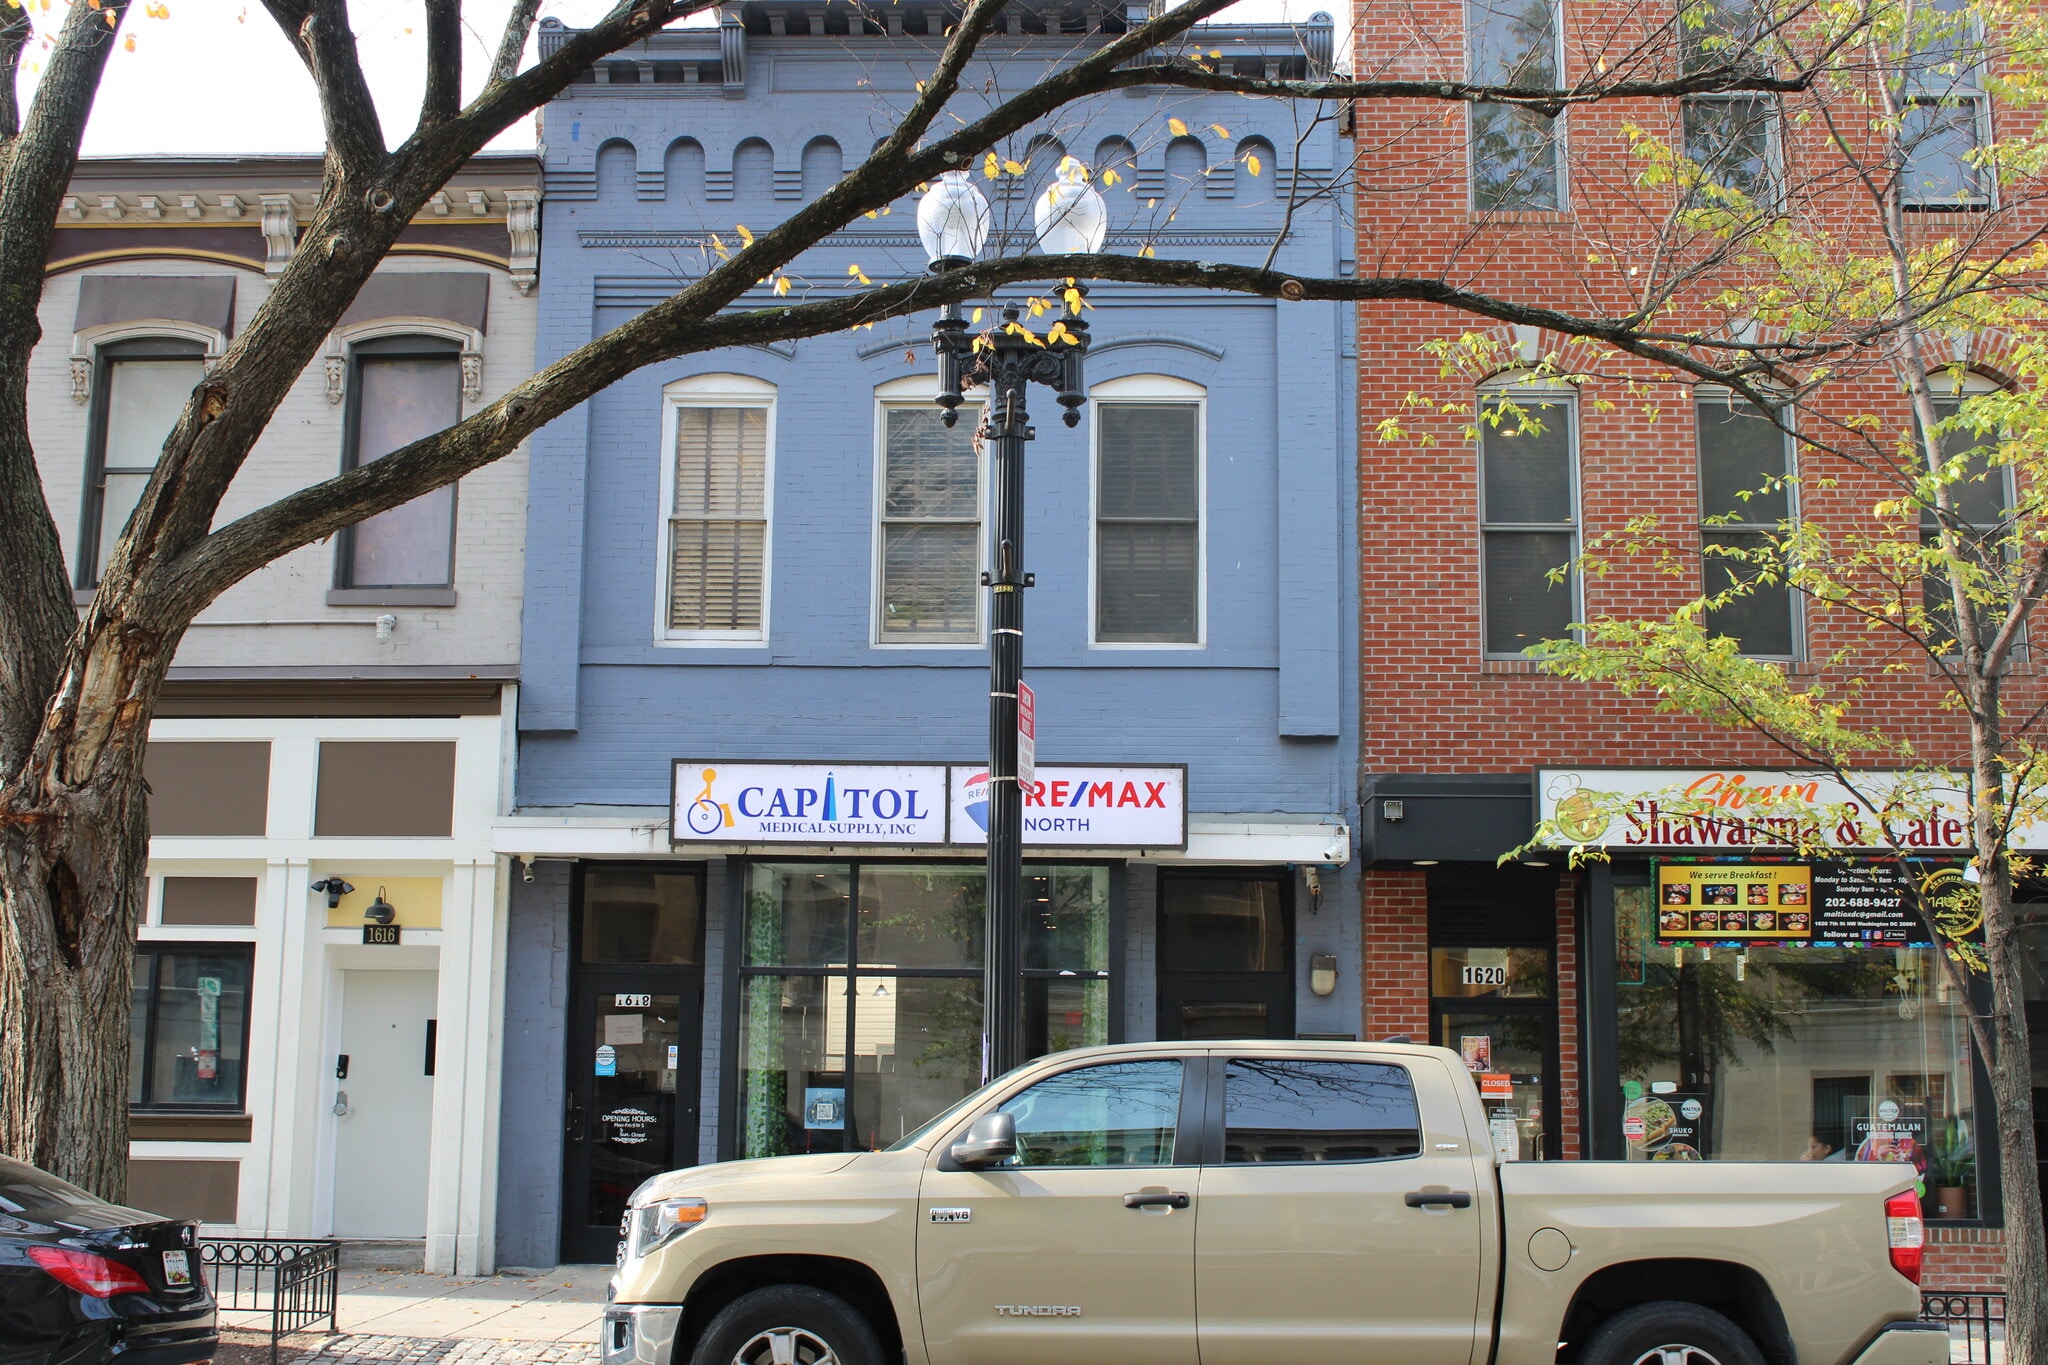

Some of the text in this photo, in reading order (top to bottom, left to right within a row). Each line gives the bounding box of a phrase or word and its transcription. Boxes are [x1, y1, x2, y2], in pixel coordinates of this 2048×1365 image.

[738, 771, 929, 821] CAPITOL
[1684, 773, 1819, 816] Sham
[759, 822, 917, 836] MEDICAL SUPPLY, INC
[1025, 818, 1090, 832] NORTH
[1625, 800, 1963, 847] Shawarma & Cafe
[1689, 871, 1703, 879] We
[1729, 870, 1772, 879] Breakfast
[1815, 876, 1839, 884] Monday
[1898, 876, 1909, 885] 10p
[1825, 898, 1902, 907] 202-688-9427
[1823, 911, 1904, 920] maltioxdc@gmail.com
[368, 927, 395, 942] 1616
[1465, 967, 1504, 984] 1620
[618, 995, 650, 1006] 1618
[602, 1115, 657, 1123] OPENING HOURS:
[1856, 1123, 1921, 1131] GUATEMALAN
[995, 1305, 1082, 1317] TUNDRA
